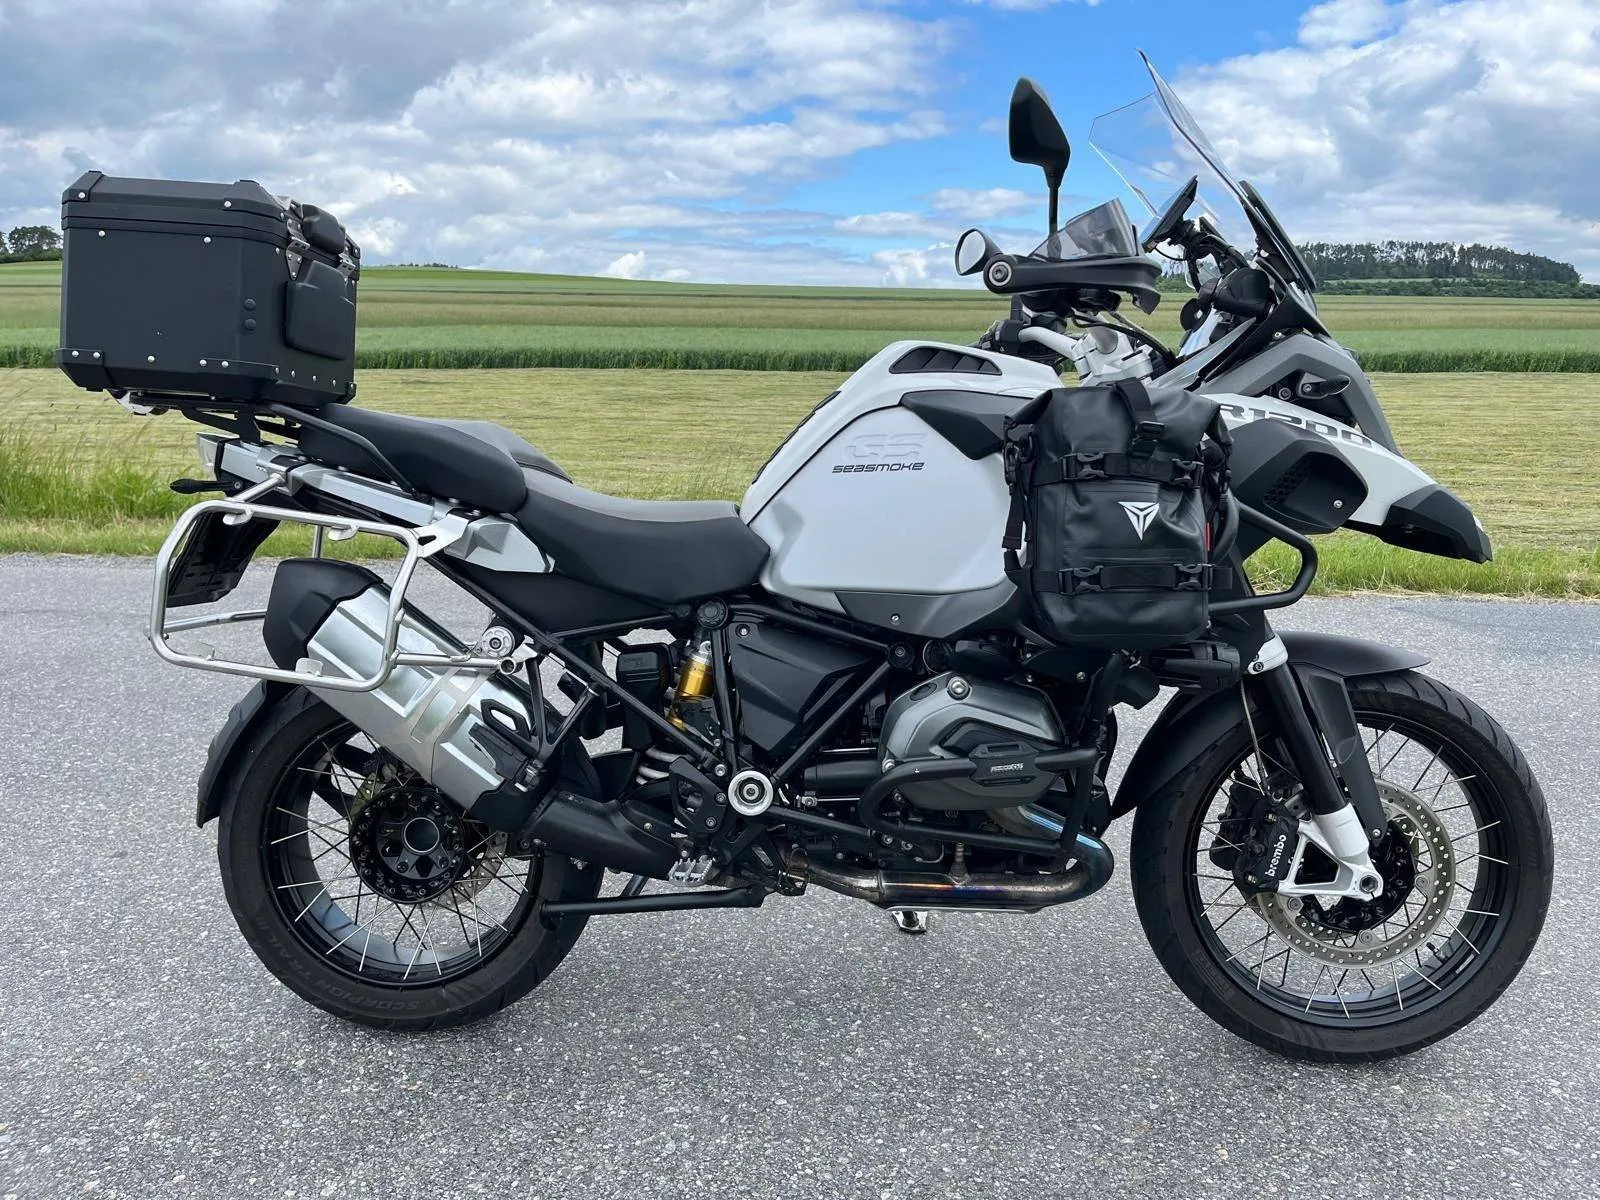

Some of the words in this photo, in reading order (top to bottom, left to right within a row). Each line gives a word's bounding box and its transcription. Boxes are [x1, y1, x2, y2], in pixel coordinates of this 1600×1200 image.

[845, 433, 928, 461] GS
[1265, 834, 1287, 877] brembo
[268, 933, 311, 979] TRAIL
[314, 979, 420, 1010] SCORPION
